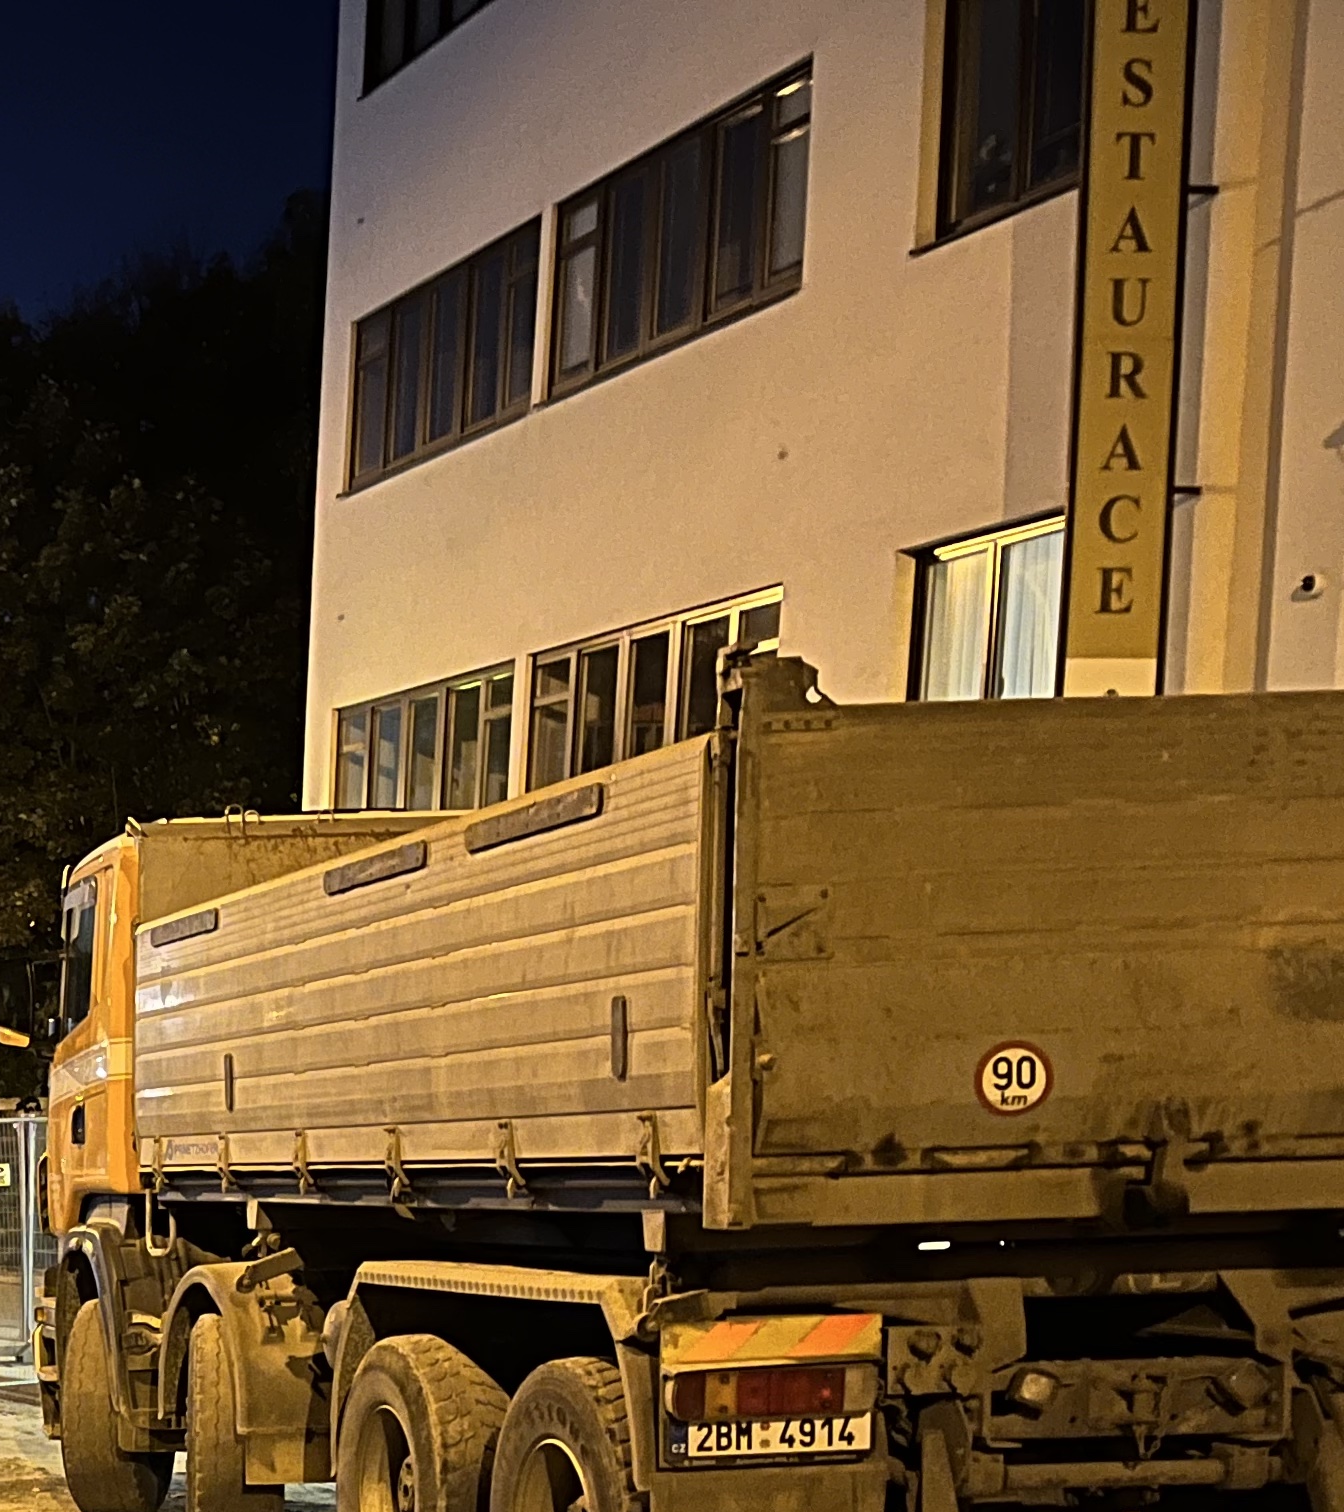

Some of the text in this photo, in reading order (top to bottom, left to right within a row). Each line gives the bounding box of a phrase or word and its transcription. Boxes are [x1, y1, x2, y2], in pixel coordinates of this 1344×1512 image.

[992, 1055, 1037, 1091] 90
[1000, 1091, 1028, 1106] km
[696, 1416, 856, 1452] 2BM 4914
[671, 1443, 686, 1454] CZ
